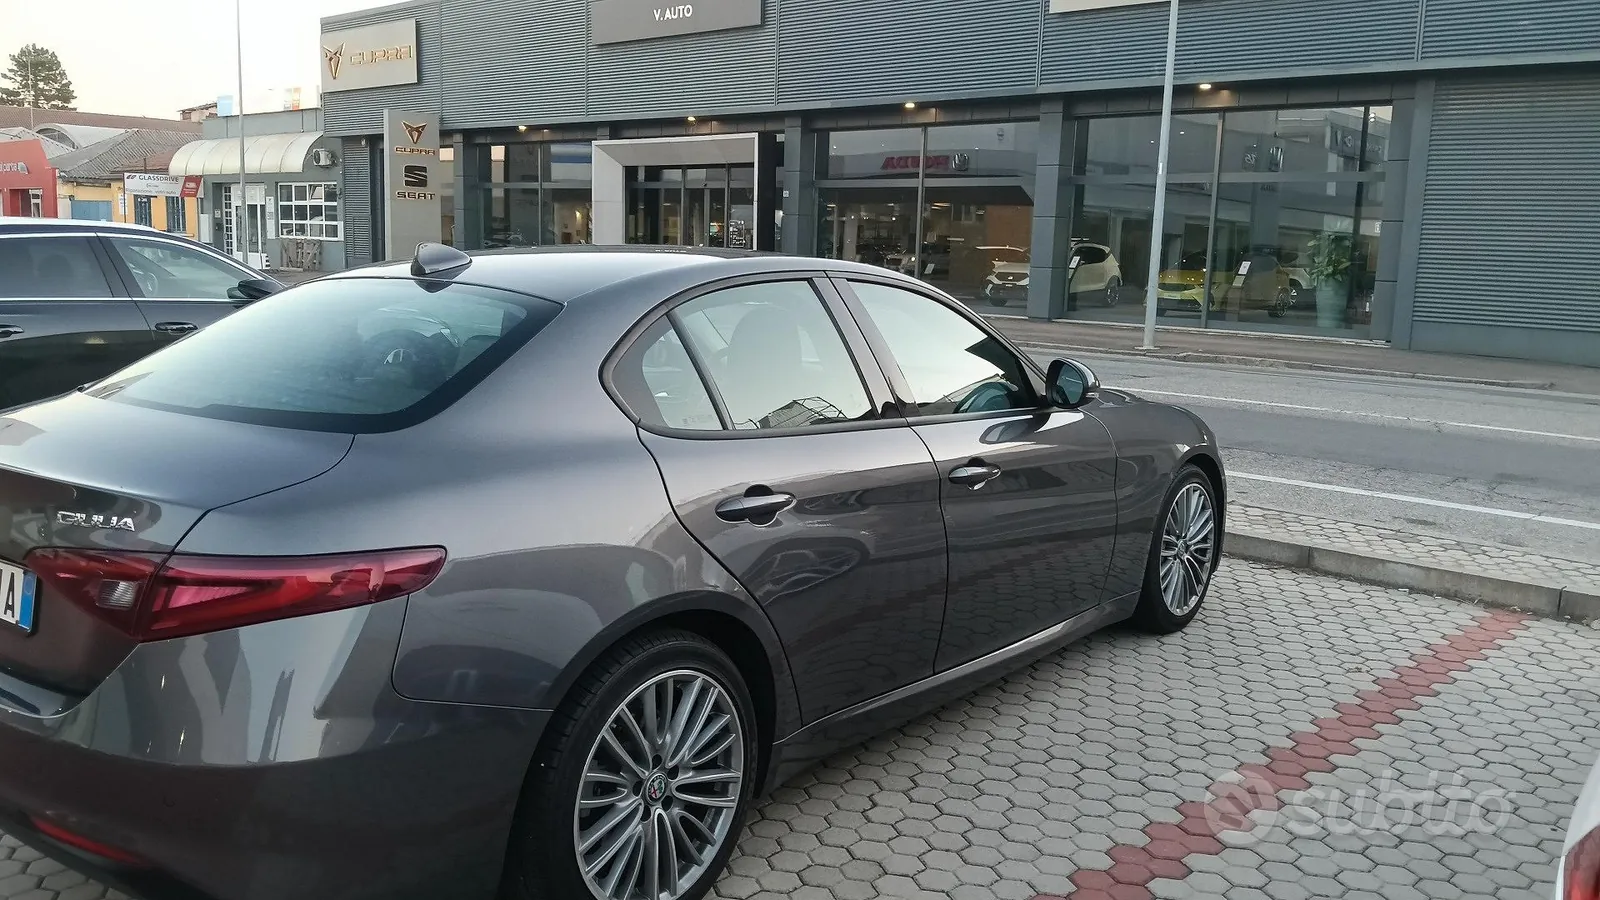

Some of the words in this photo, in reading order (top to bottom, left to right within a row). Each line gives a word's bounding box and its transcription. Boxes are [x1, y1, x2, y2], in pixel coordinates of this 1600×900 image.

[653, 4, 693, 21] V.AUTO
[349, 45, 413, 65] CUPRA
[395, 146, 436, 156] CUPRA
[138, 175, 179, 183] GLASSDRIVE
[396, 191, 436, 200] SEAT
[56, 510, 135, 532] GIULIA
[0, 568, 15, 618] A
